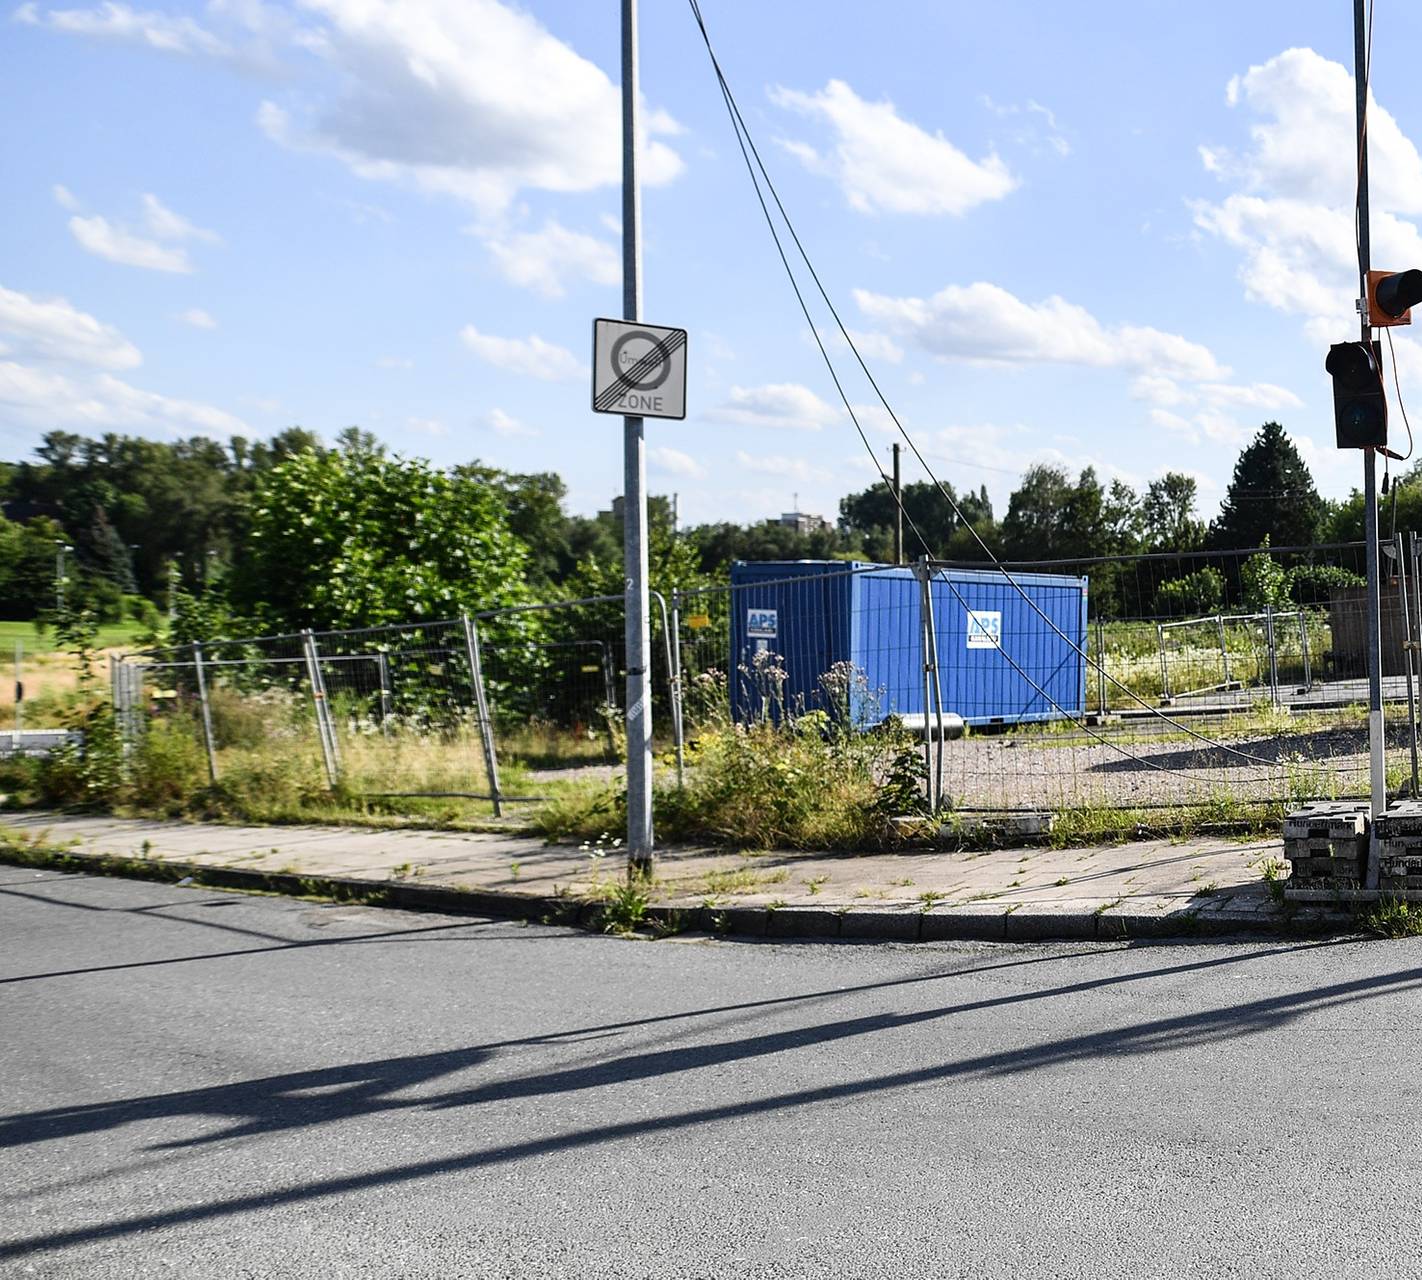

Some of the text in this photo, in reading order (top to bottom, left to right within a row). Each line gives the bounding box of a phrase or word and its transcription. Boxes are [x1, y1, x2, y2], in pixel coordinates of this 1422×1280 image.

[618, 394, 663, 411] ZONE
[626, 577, 634, 590] 2
[750, 614, 775, 628] APS
[970, 617, 998, 634] APS
